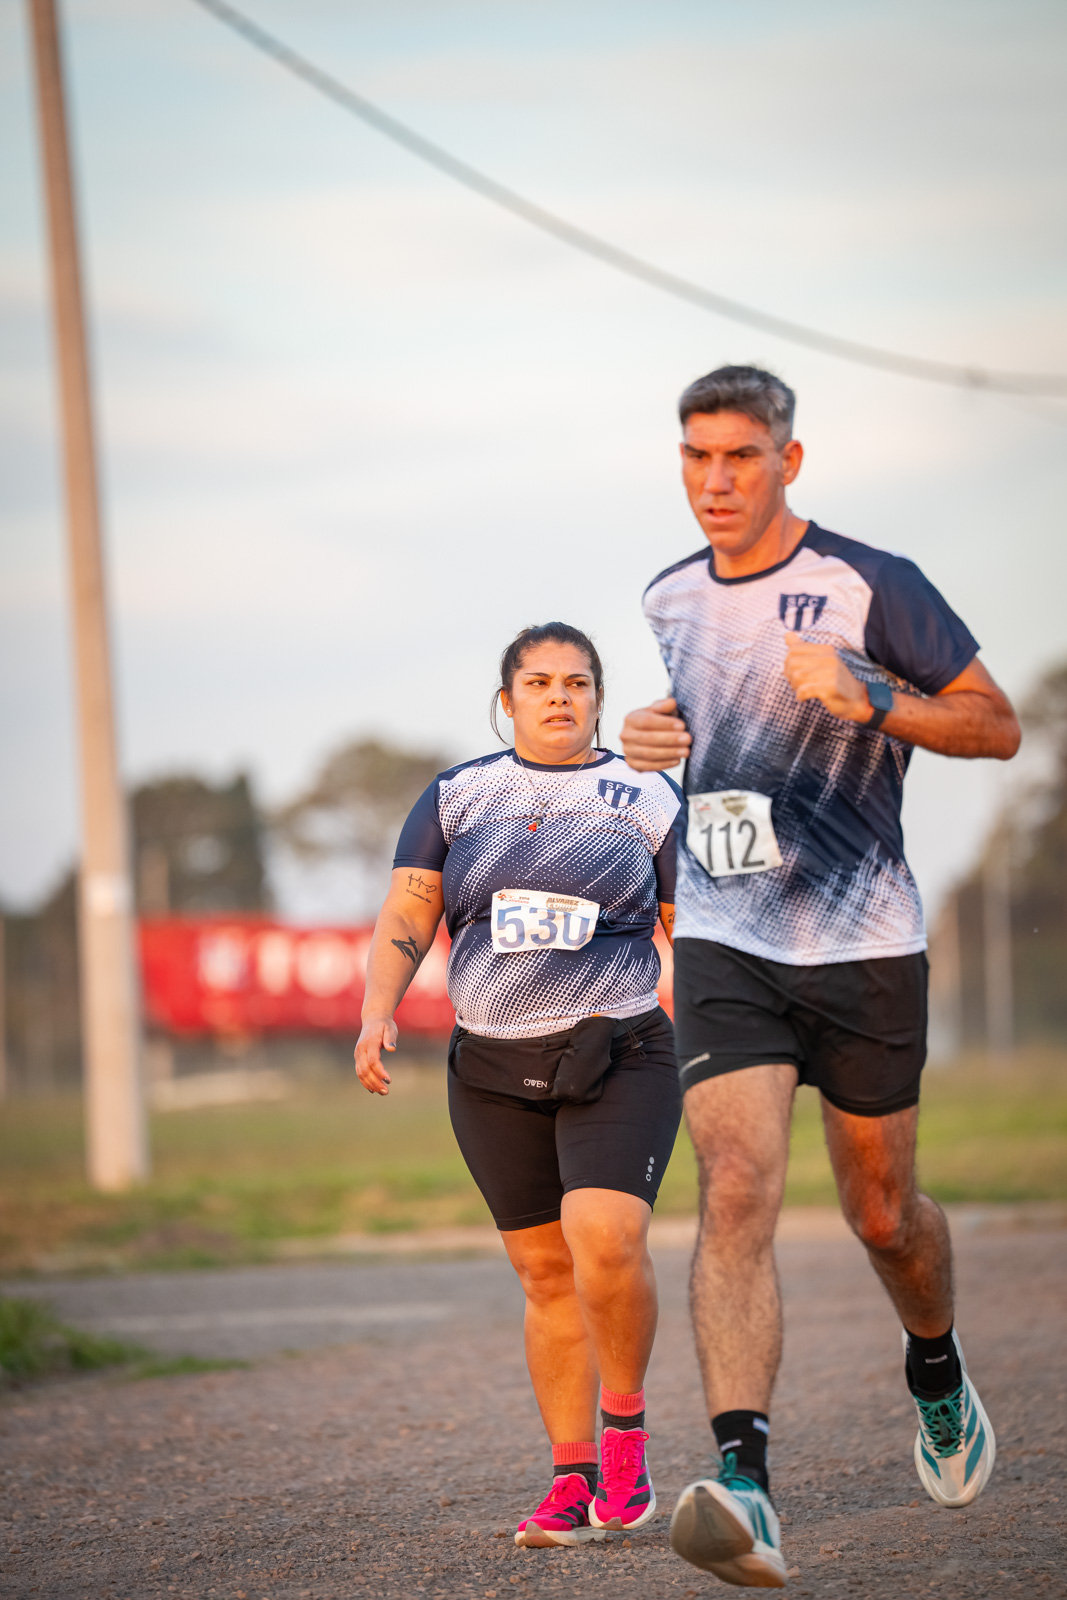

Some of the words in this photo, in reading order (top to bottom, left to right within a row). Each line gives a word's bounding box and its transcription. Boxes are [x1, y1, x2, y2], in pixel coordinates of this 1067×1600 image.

[786, 596, 819, 608] SFC
[605, 781, 633, 794] SFC
[700, 819, 765, 872] 112
[547, 897, 579, 906] ALVAREZ
[497, 906, 590, 949] 530
